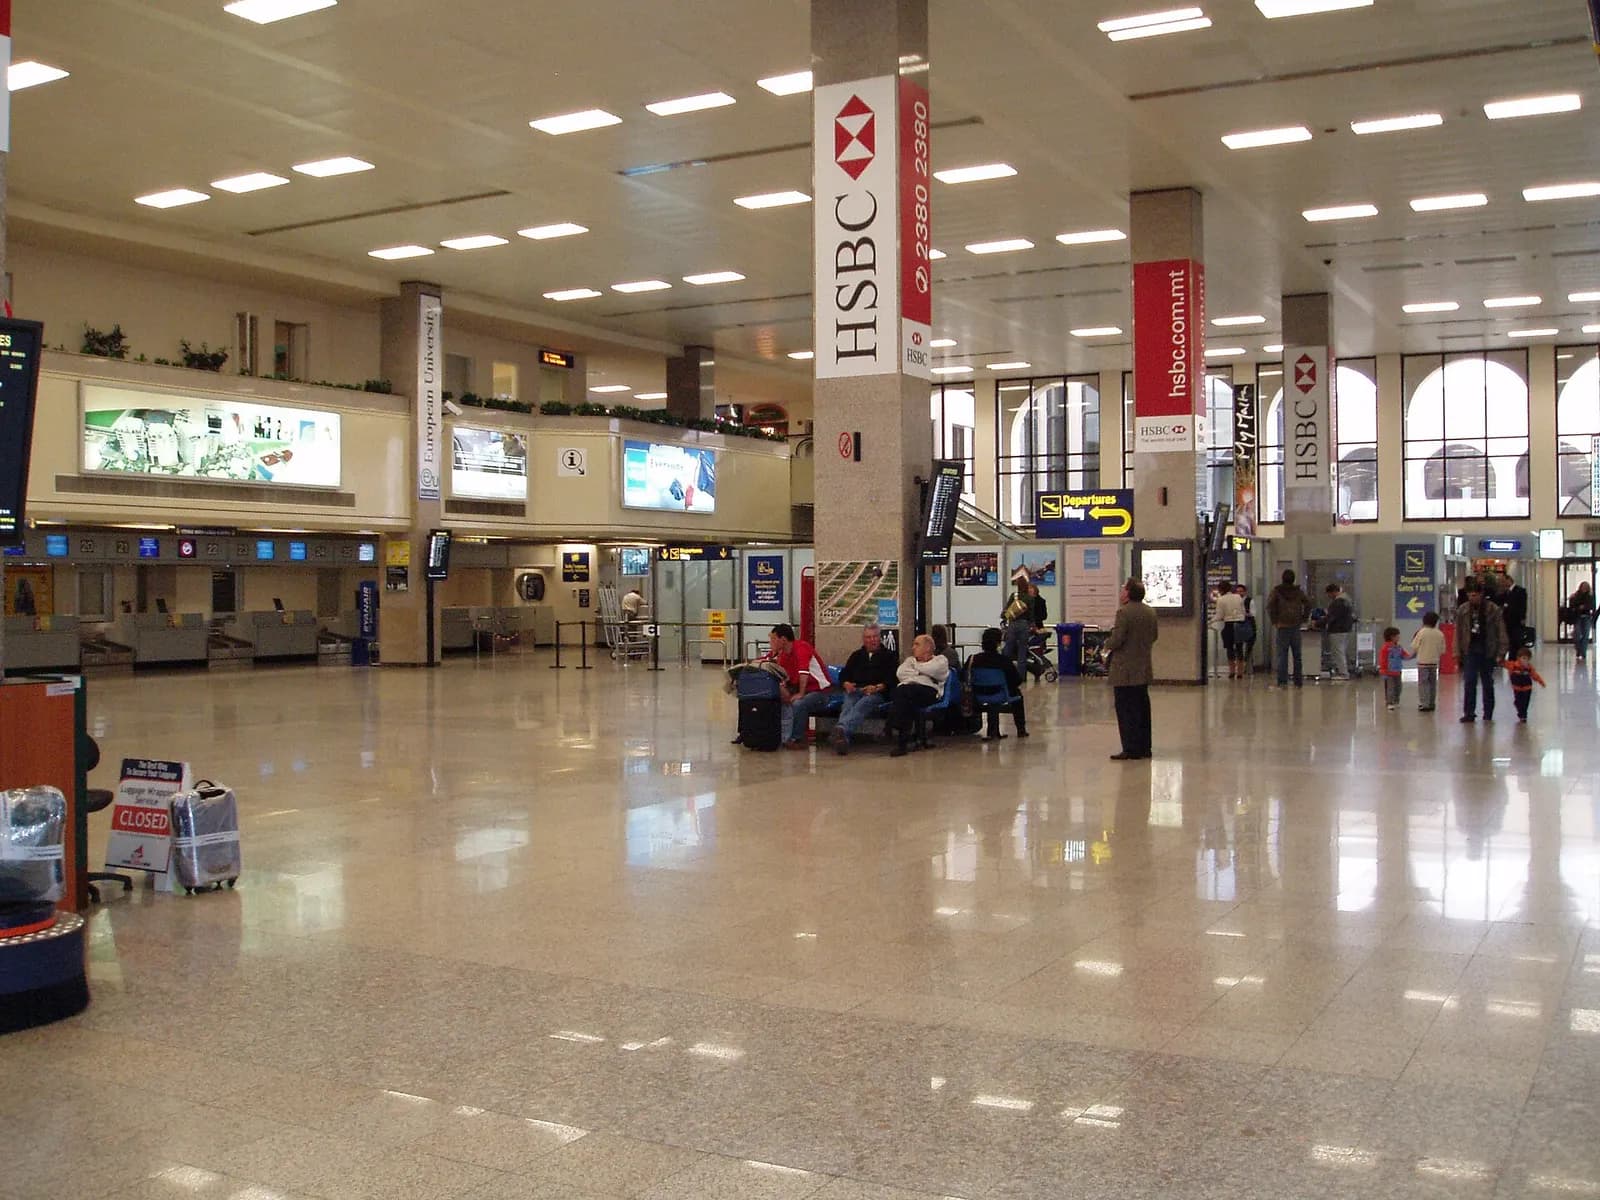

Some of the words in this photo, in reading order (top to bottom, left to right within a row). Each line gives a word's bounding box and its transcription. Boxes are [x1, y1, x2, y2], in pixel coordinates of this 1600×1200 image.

[914, 101, 928, 176] 2380
[915, 185, 929, 260] 2380
[835, 190, 878, 365] HSBC
[424, 305, 437, 384] University
[907, 347, 928, 367] HSBC
[1168, 269, 1186, 397] hsbc.com.mt
[424, 390, 436, 463] European
[1141, 425, 1171, 437] HSBC
[1235, 431, 1256, 459] My
[1295, 401, 1317, 480] HSBC
[1063, 494, 1117, 508] Departures
[207, 544, 218, 554] 22
[120, 810, 168, 829] CLOSED
